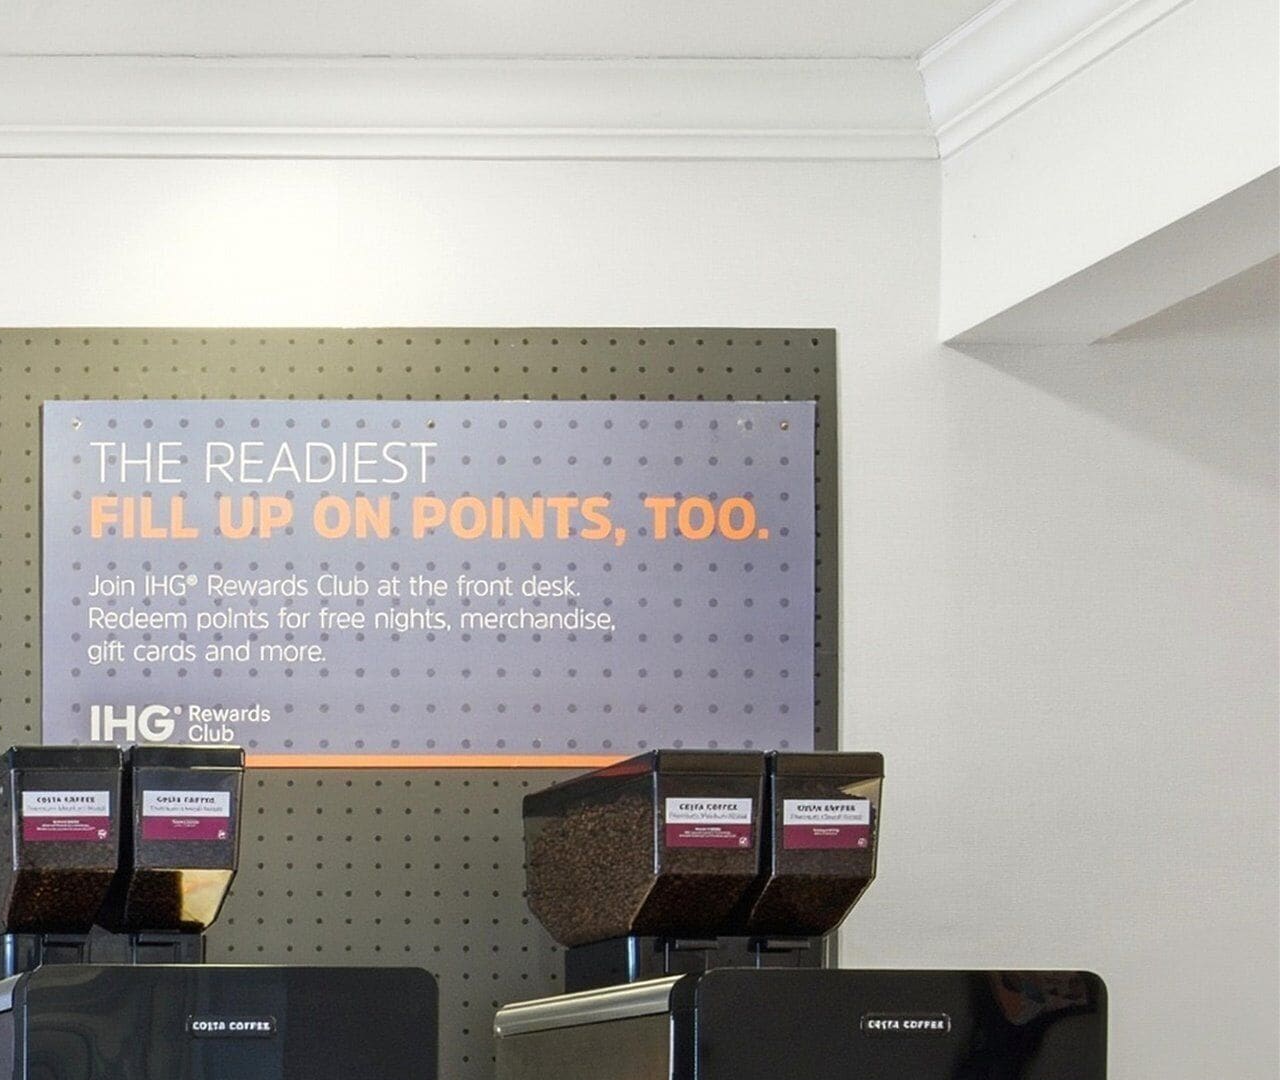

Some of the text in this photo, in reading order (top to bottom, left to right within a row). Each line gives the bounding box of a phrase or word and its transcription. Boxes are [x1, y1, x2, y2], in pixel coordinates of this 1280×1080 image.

[90, 442, 437, 484] THE READIEST
[89, 496, 769, 546] FILL UP ON POINTS, TOO.
[88, 575, 134, 598] Join
[207, 574, 308, 597] Rewards
[317, 574, 369, 597] Club
[378, 577, 402, 597] at
[409, 574, 448, 597] the
[456, 574, 512, 597] front
[522, 574, 581, 597] desk.
[88, 606, 616, 633] Redeem points for free nights, merchandise,
[88, 639, 326, 665] gift cards and more.
[188, 706, 271, 723] Rewards
[188, 724, 235, 743] Club
[192, 1021, 226, 1031] COSTA
